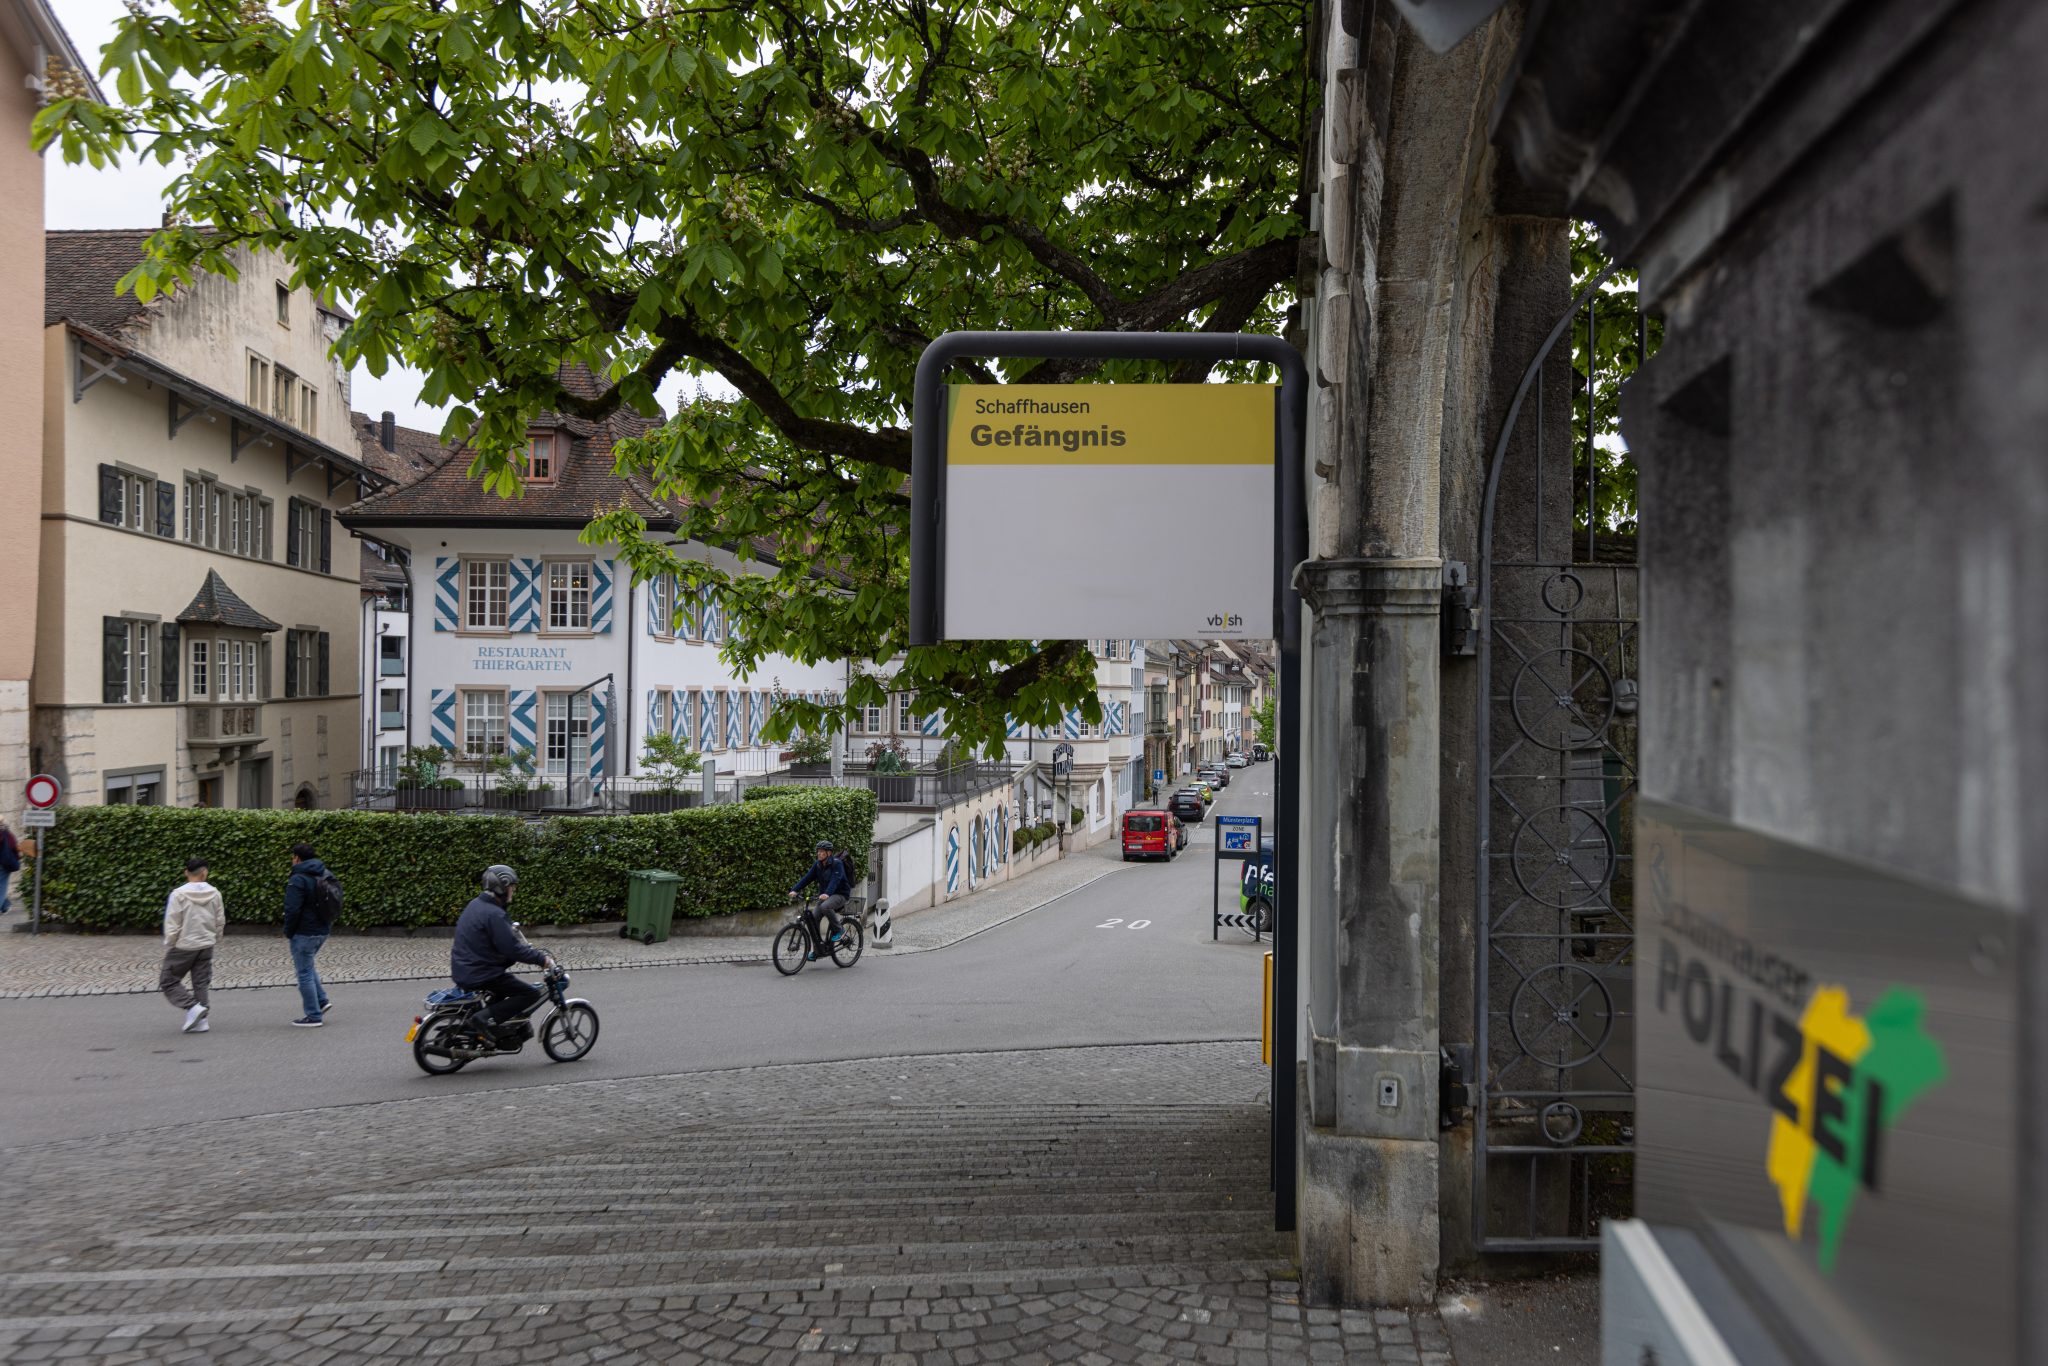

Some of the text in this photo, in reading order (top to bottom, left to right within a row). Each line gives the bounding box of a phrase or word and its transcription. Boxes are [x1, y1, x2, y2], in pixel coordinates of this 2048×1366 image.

[975, 399, 1090, 414] Schaffhausen
[970, 424, 1127, 452] Gefängnis
[478, 646, 567, 658] RESTAURANT
[472, 659, 572, 671] THIERGARTEN
[1095, 918, 1152, 930] 20
[1656, 937, 1885, 1193] POLIZEI
